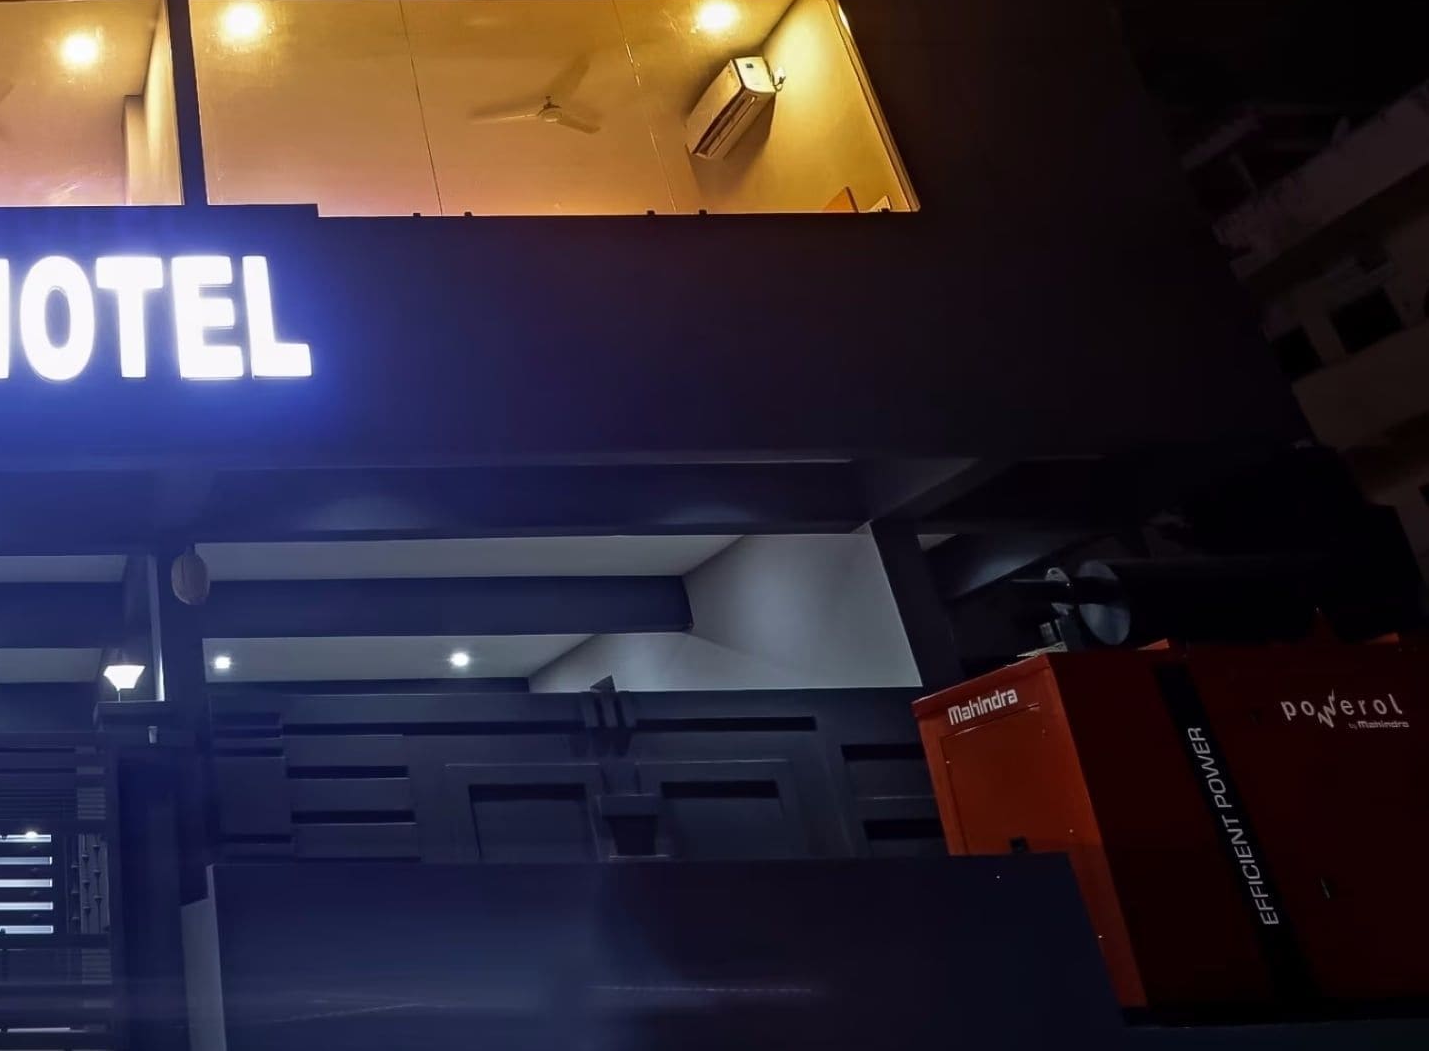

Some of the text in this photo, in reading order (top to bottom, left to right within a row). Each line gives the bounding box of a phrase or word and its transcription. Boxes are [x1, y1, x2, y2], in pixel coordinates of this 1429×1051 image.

[947, 688, 1019, 726] Mahindra
[1187, 727, 1279, 925] EFFICIENT POWER
